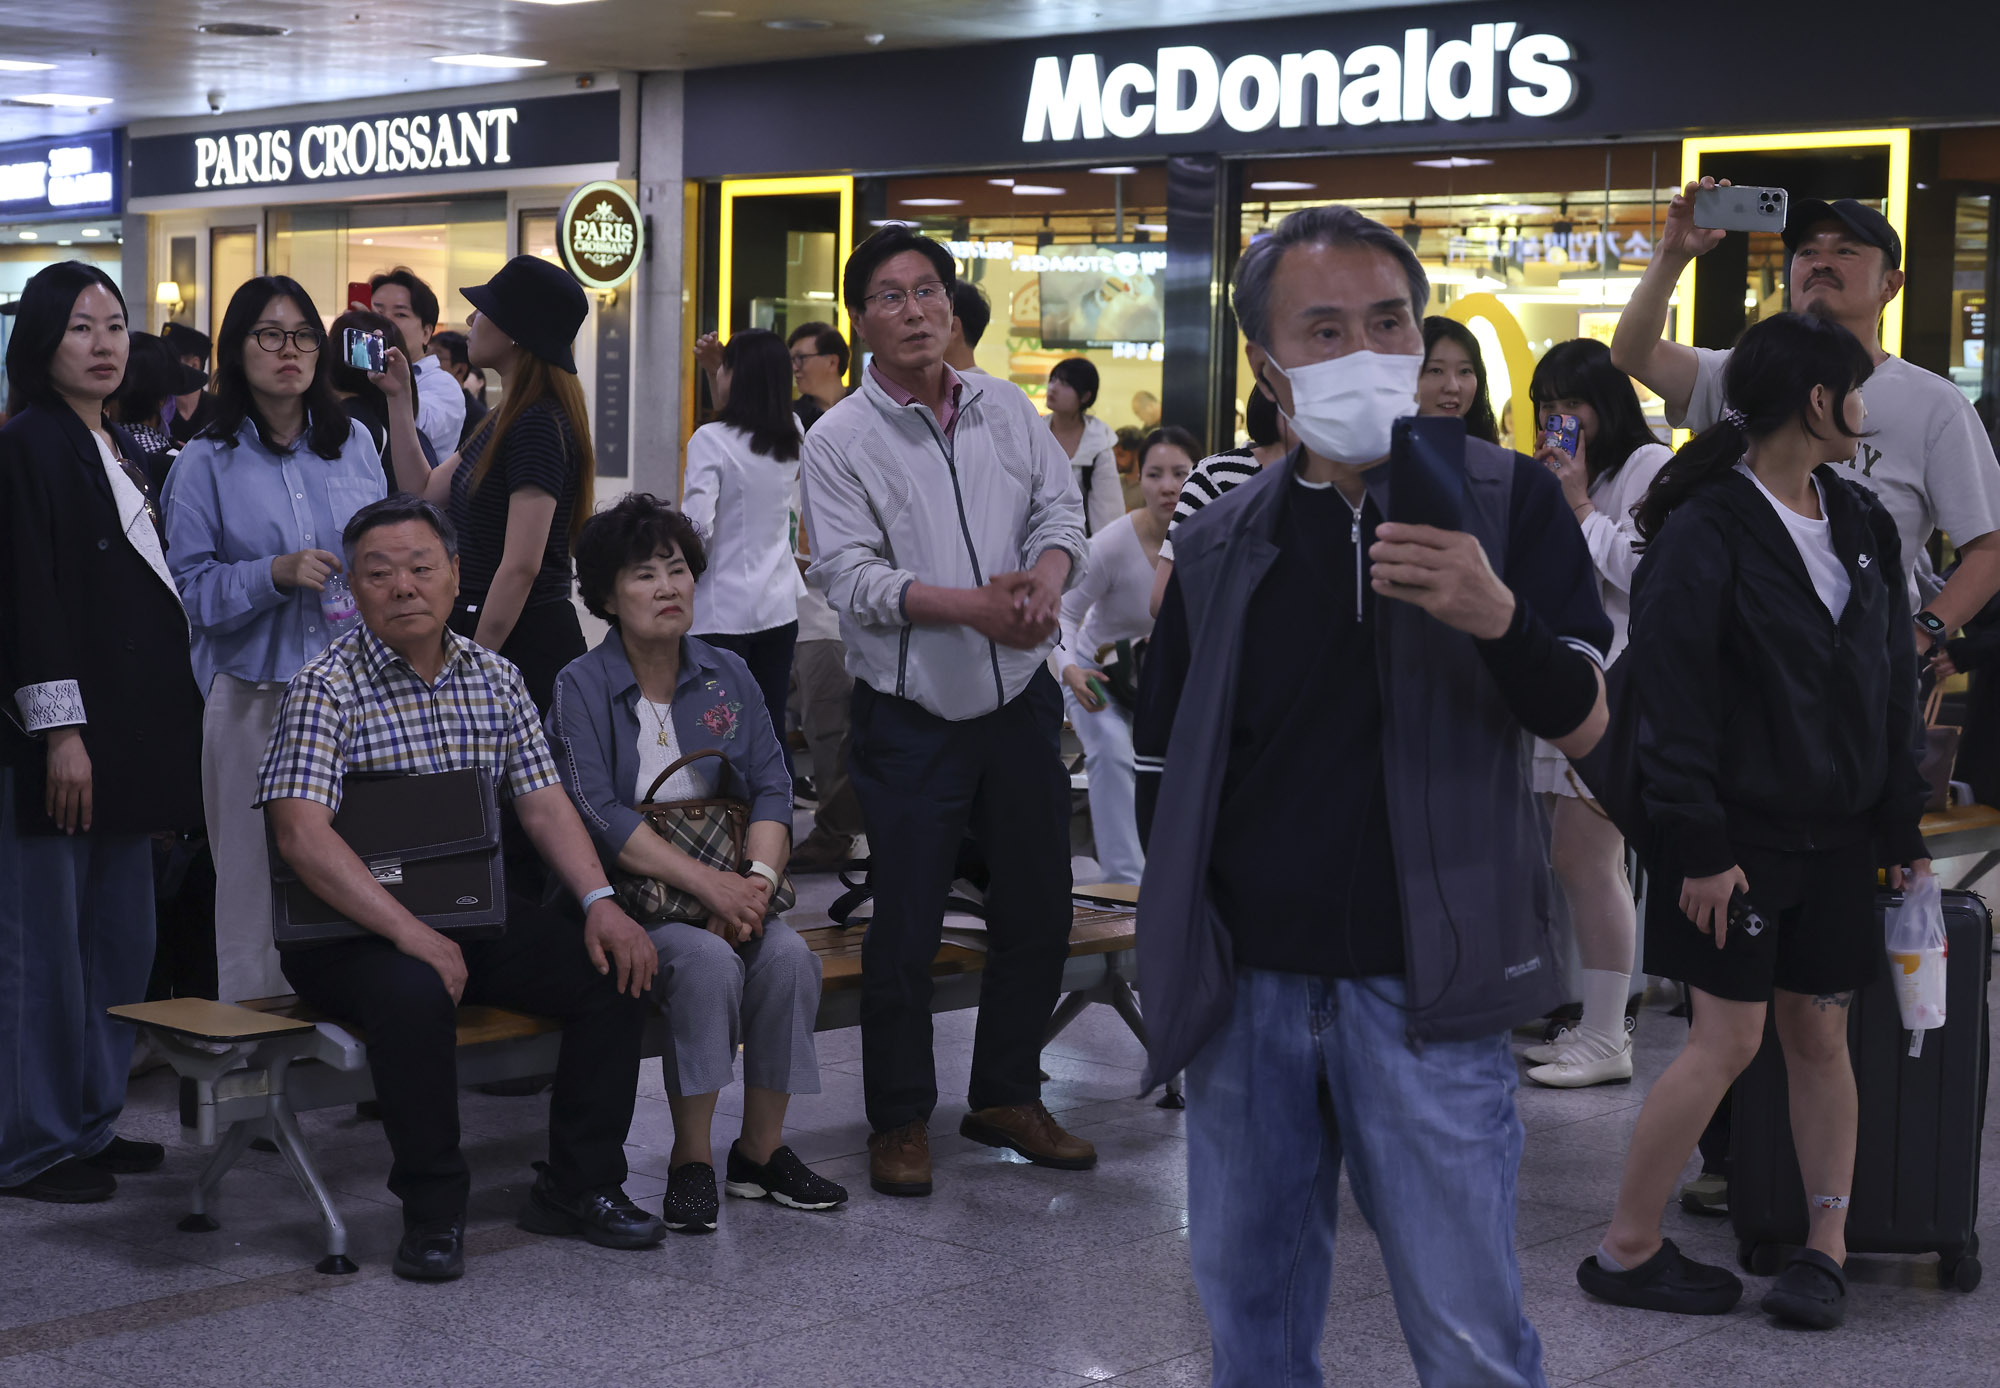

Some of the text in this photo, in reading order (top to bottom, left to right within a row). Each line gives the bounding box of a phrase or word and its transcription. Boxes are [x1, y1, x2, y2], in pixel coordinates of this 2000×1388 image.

[1022, 22, 1575, 142] McDonald's
[194, 108, 518, 188] PARIS CROISSANT
[573, 220, 634, 243] PARIS
[573, 240, 633, 256] CROISSANT
